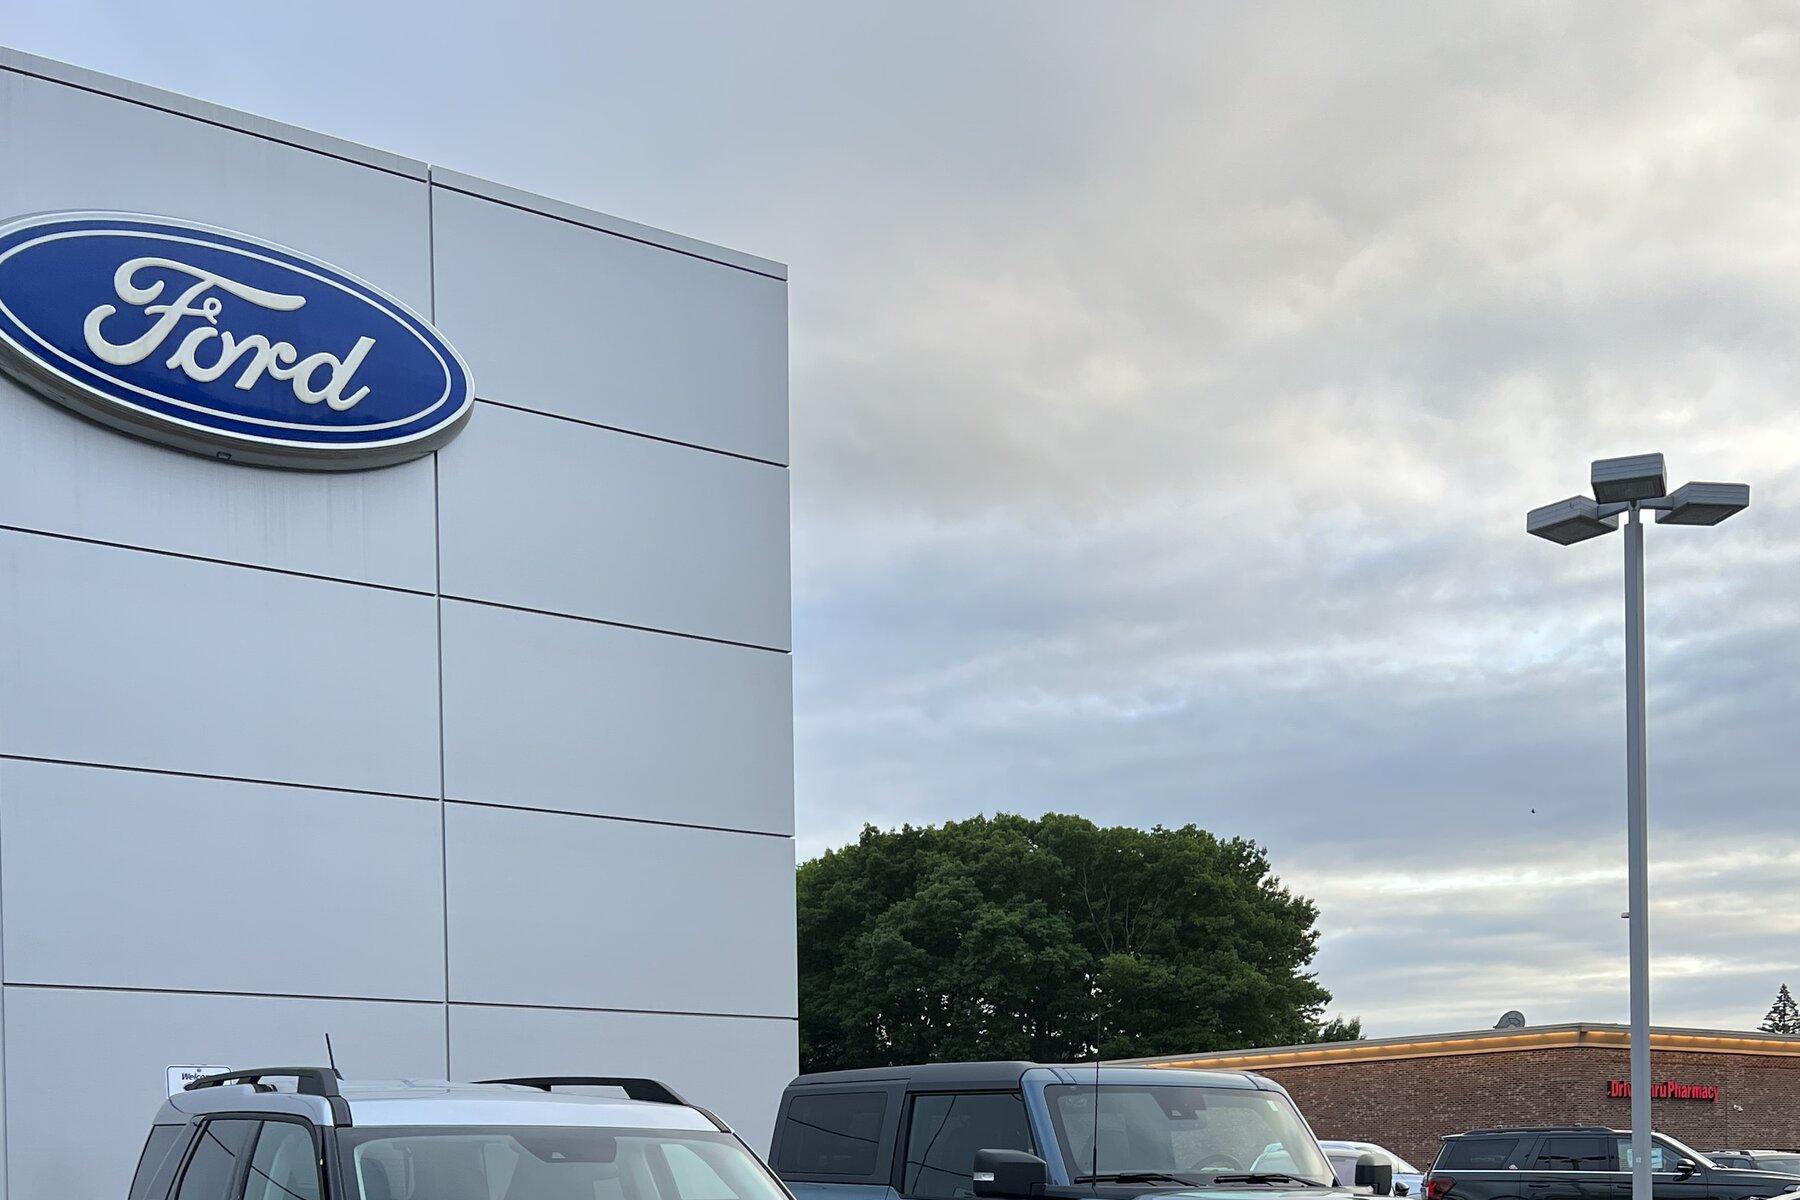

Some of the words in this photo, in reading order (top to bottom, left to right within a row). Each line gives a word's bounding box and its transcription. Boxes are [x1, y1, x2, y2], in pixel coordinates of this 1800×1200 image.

[83, 257, 377, 412] Ford
[181, 1072, 208, 1081] Welco
[1667, 1081, 1719, 1102] Pharmacy
